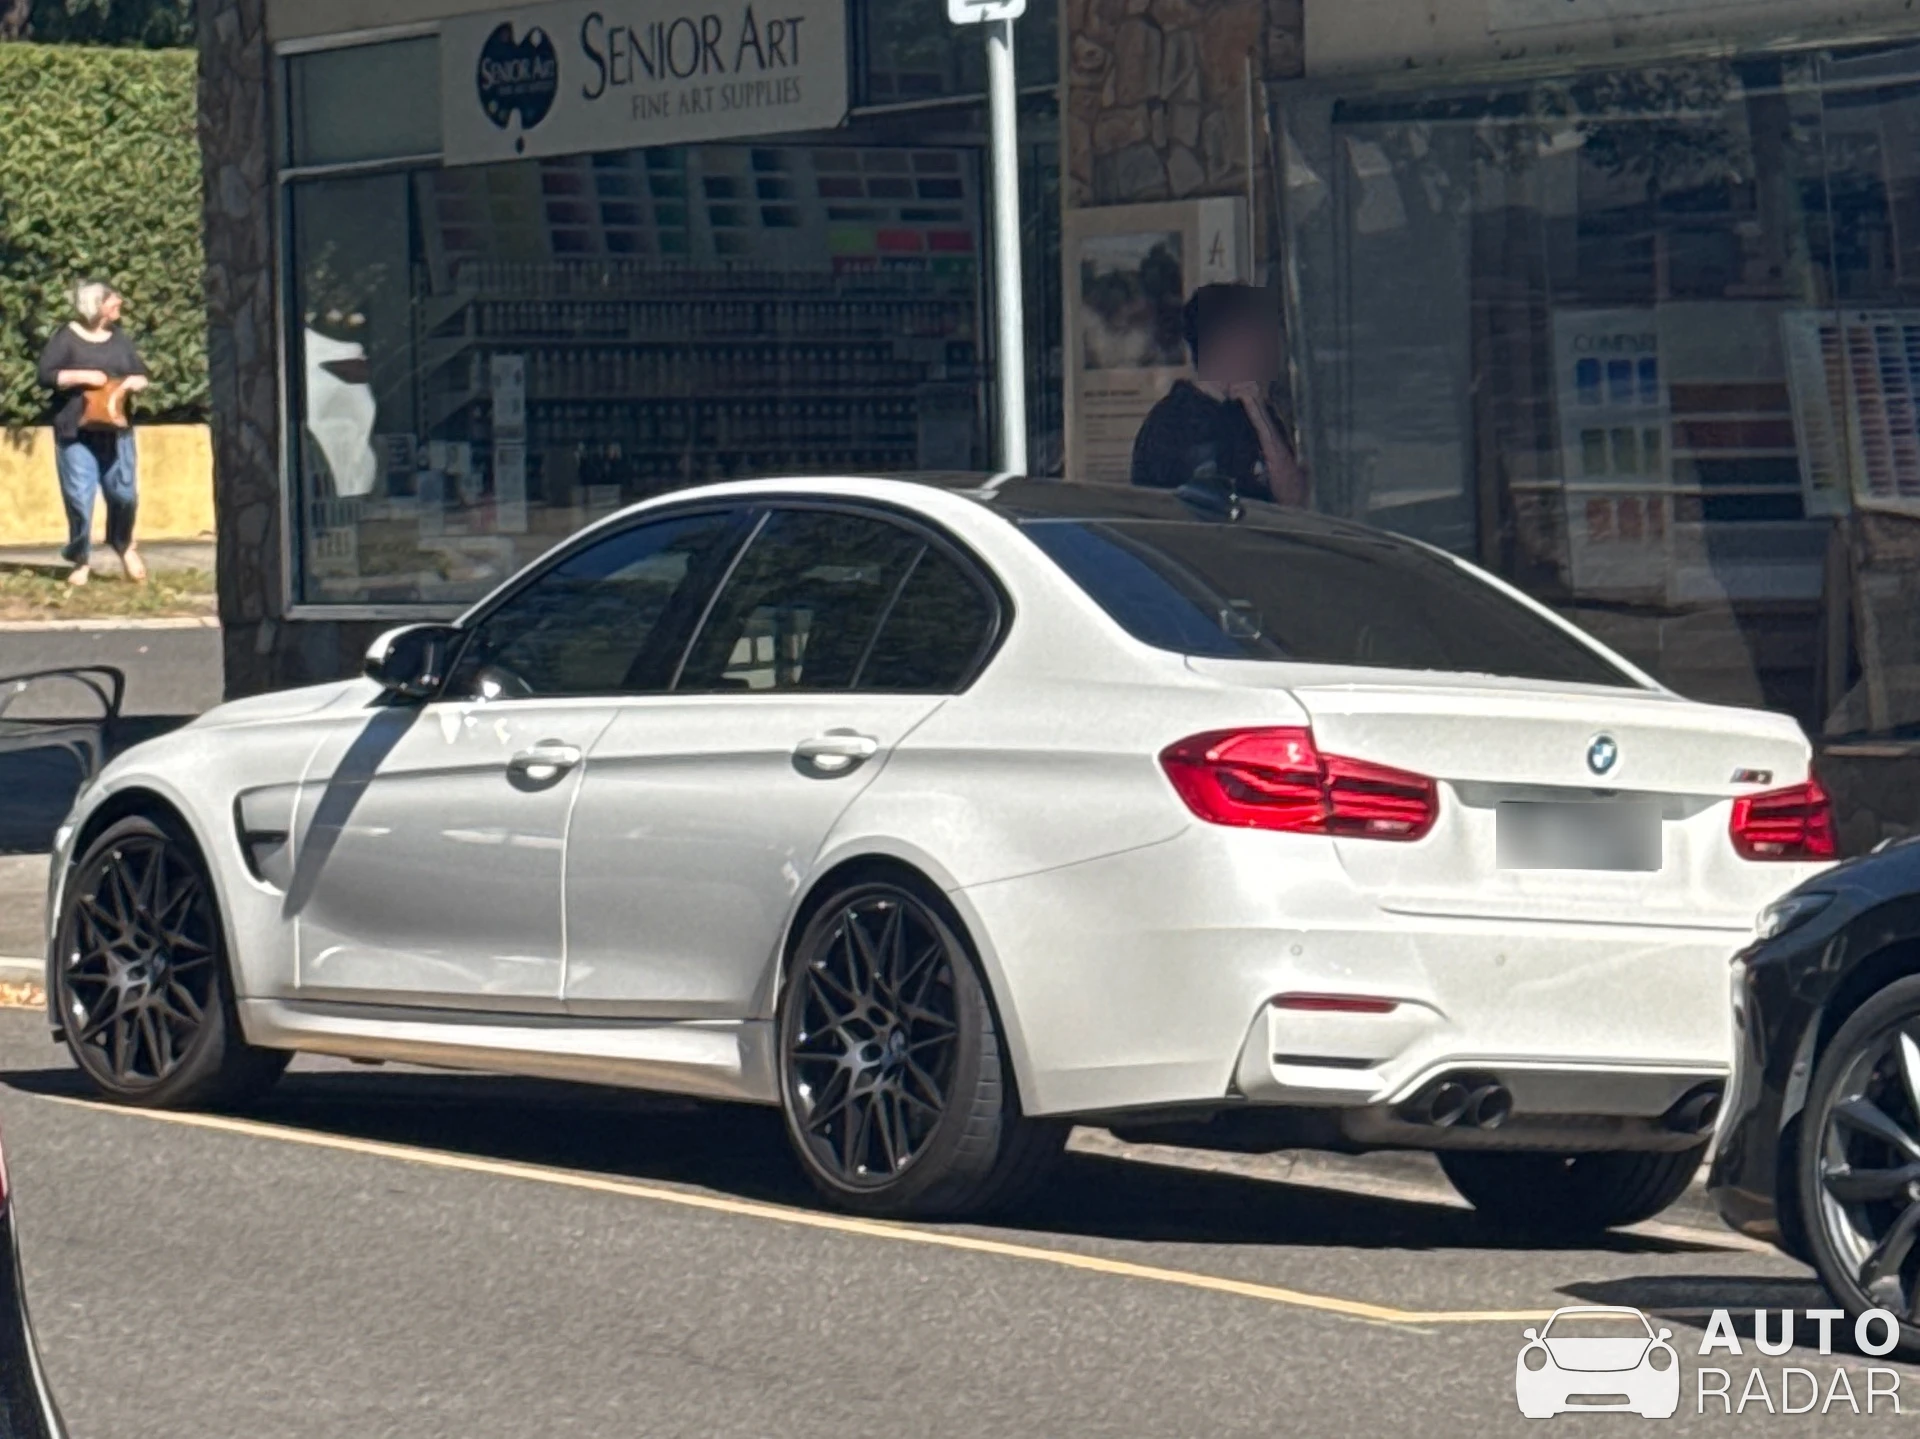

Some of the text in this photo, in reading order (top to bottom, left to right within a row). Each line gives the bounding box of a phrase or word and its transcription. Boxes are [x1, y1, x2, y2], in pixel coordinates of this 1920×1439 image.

[581, 4, 806, 100] SENIOR ART
[631, 76, 803, 121] FINE ART SUPPLIES
